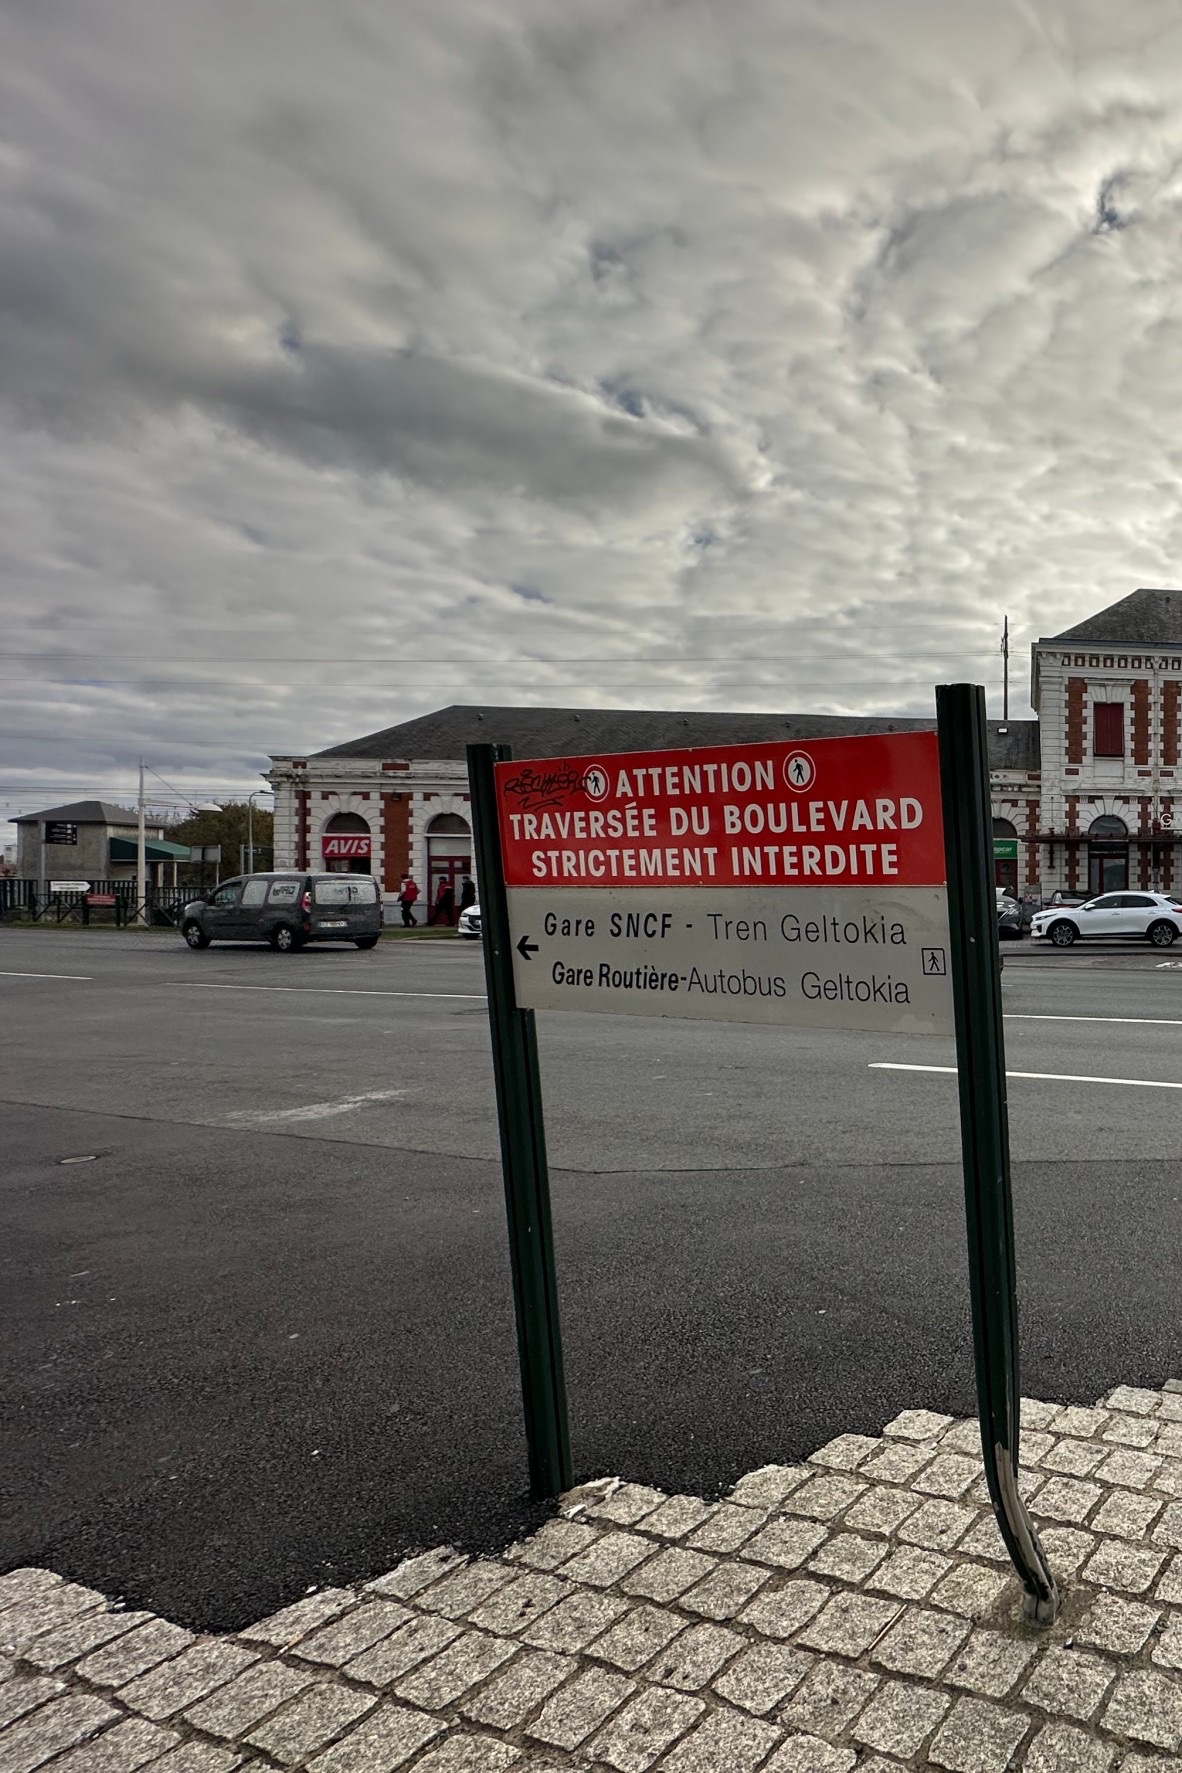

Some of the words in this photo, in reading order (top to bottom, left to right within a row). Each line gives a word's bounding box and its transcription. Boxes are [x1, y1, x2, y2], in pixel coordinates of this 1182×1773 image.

[615, 760, 775, 799] ATTENTION
[509, 801, 657, 840] TRAVERSÉE
[669, 805, 710, 836] DU
[723, 797, 923, 835] BOULEVARD
[324, 839, 370, 854] AVIS
[531, 847, 718, 878] STRICTEMENT
[731, 843, 899, 877] INTERDITE
[544, 911, 595, 937] Gare
[609, 912, 673, 939] SNCF
[706, 913, 767, 942] Tren
[780, 914, 908, 945] Geltokia
[552, 960, 594, 987] Gare
[801, 971, 911, 1005] Geltokia
